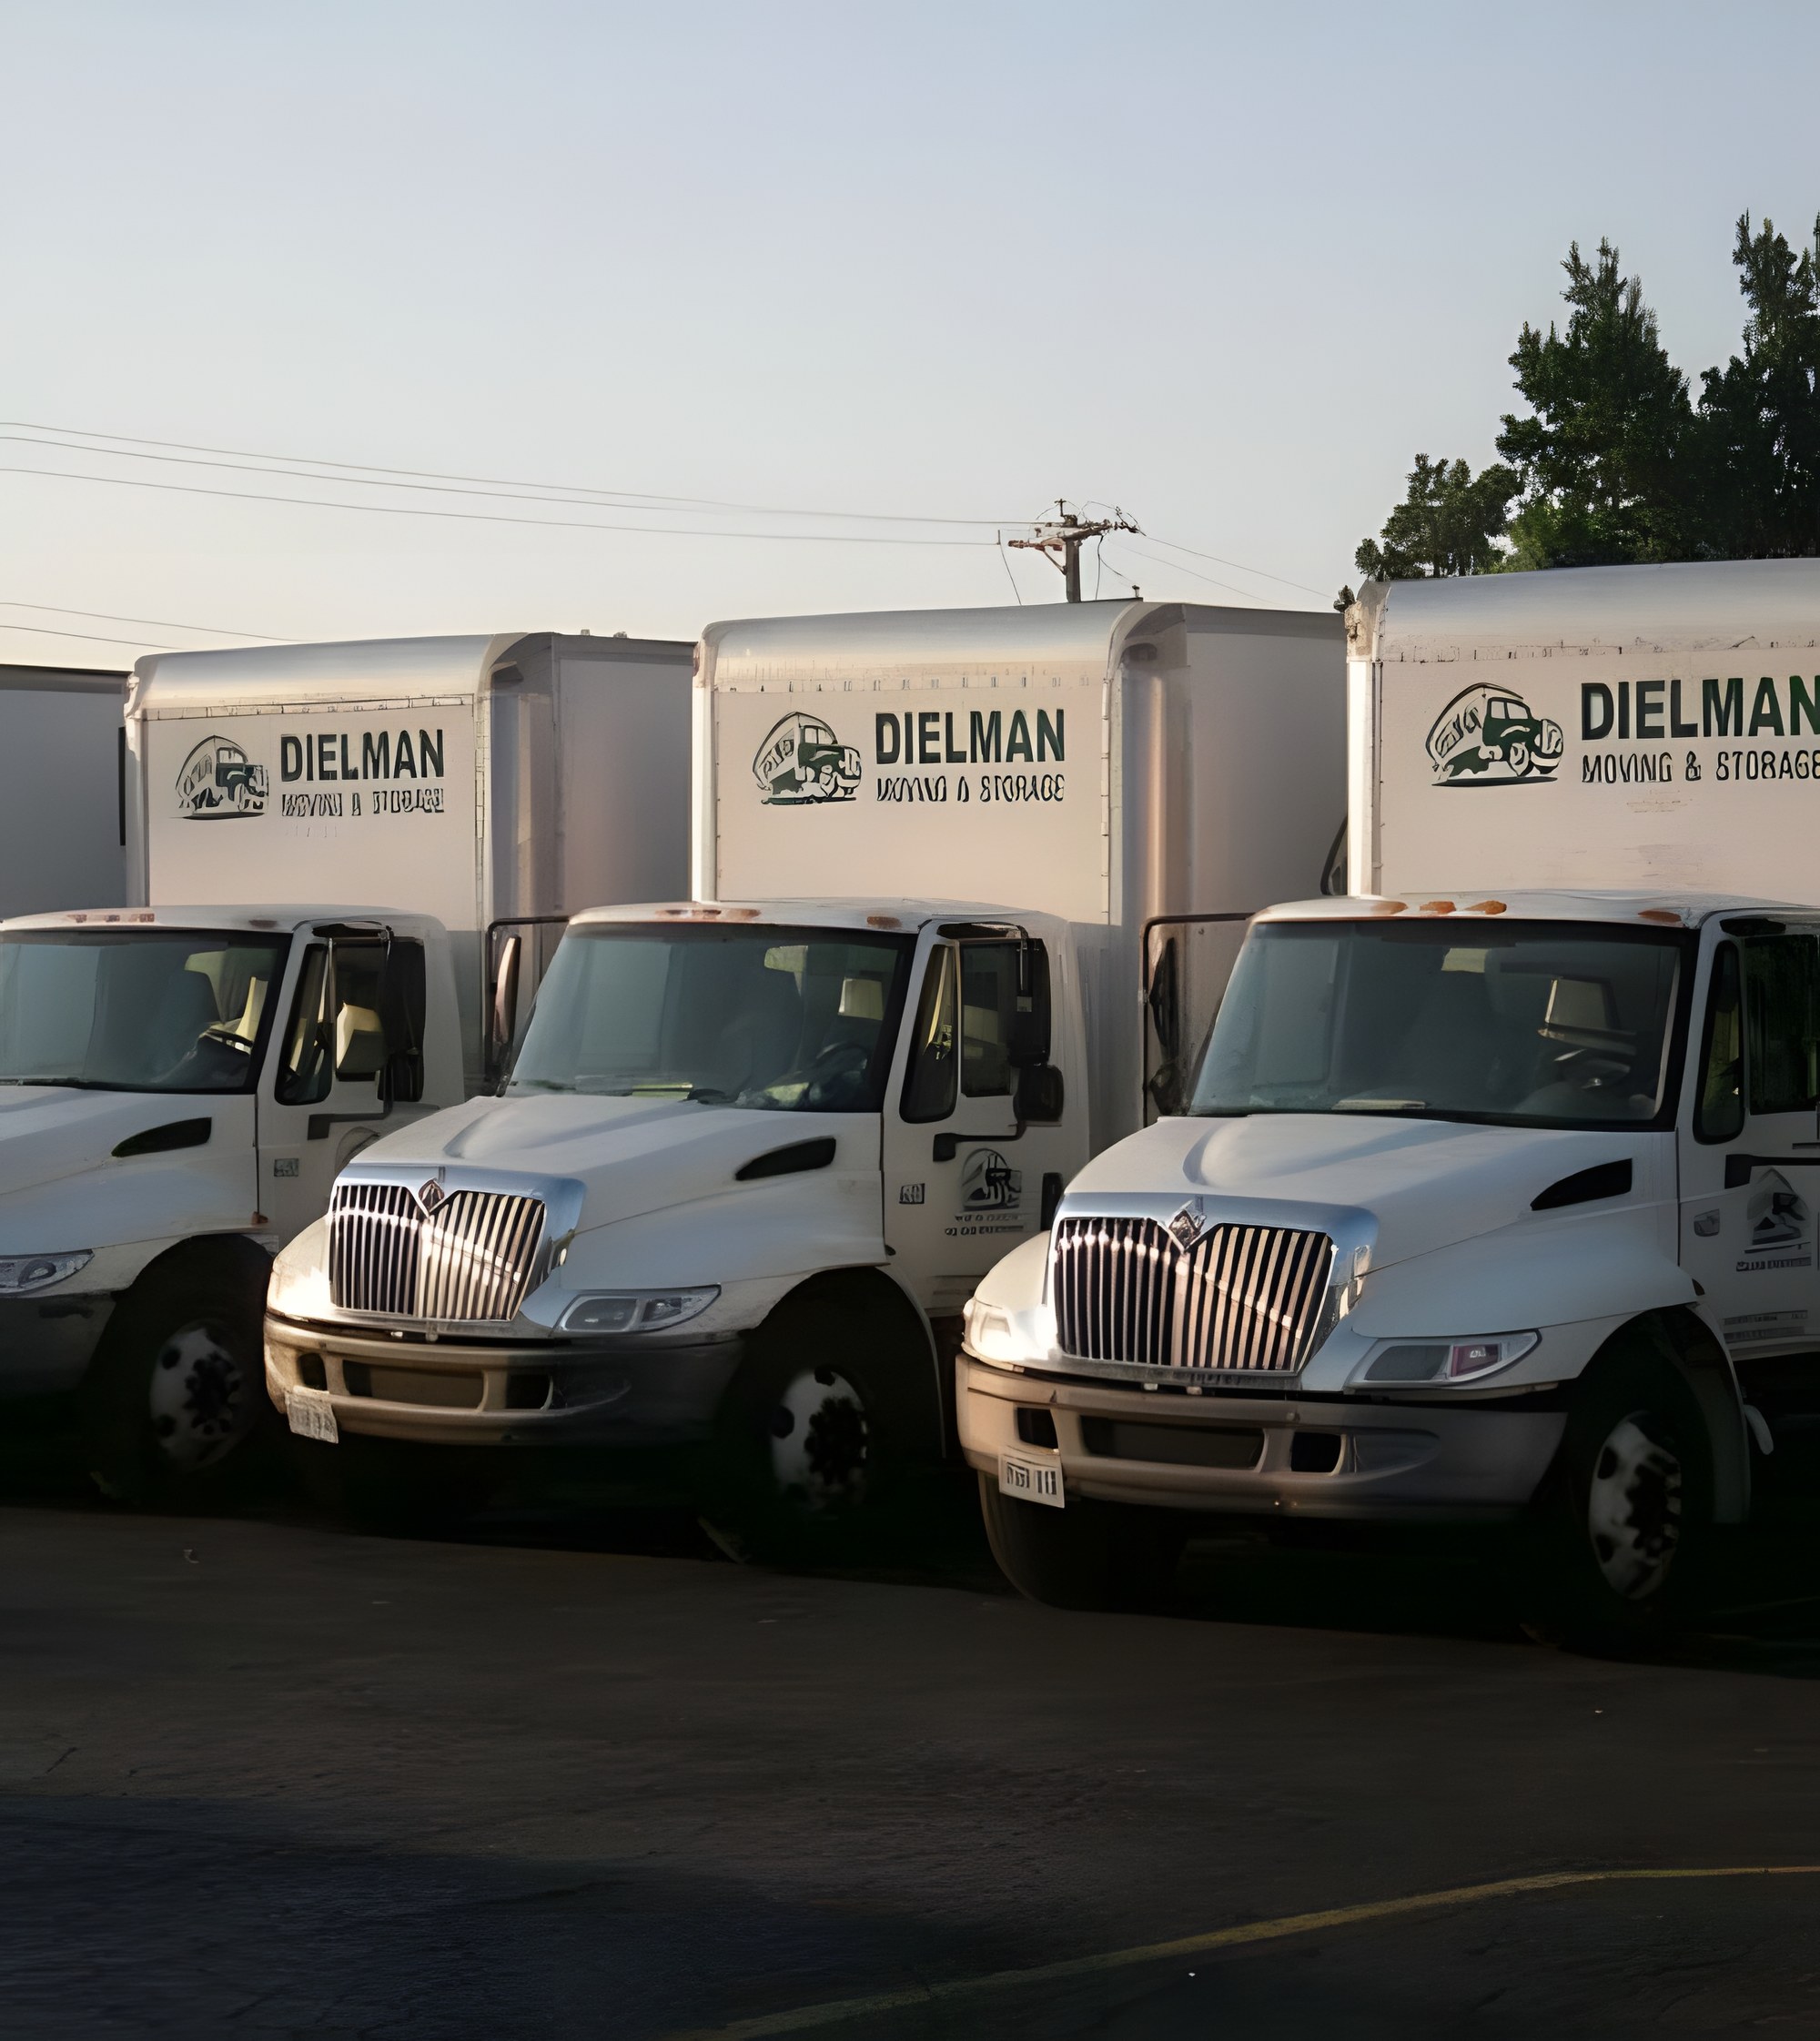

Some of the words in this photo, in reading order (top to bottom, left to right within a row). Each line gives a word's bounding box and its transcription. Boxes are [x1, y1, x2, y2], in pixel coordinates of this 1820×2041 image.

[1581, 675, 1820, 741] DIELMAN
[280, 729, 444, 782] DIELMAN
[875, 708, 1065, 765] DIELMAN
[1582, 752, 1673, 783] MOVING
[1684, 750, 1702, 782] &
